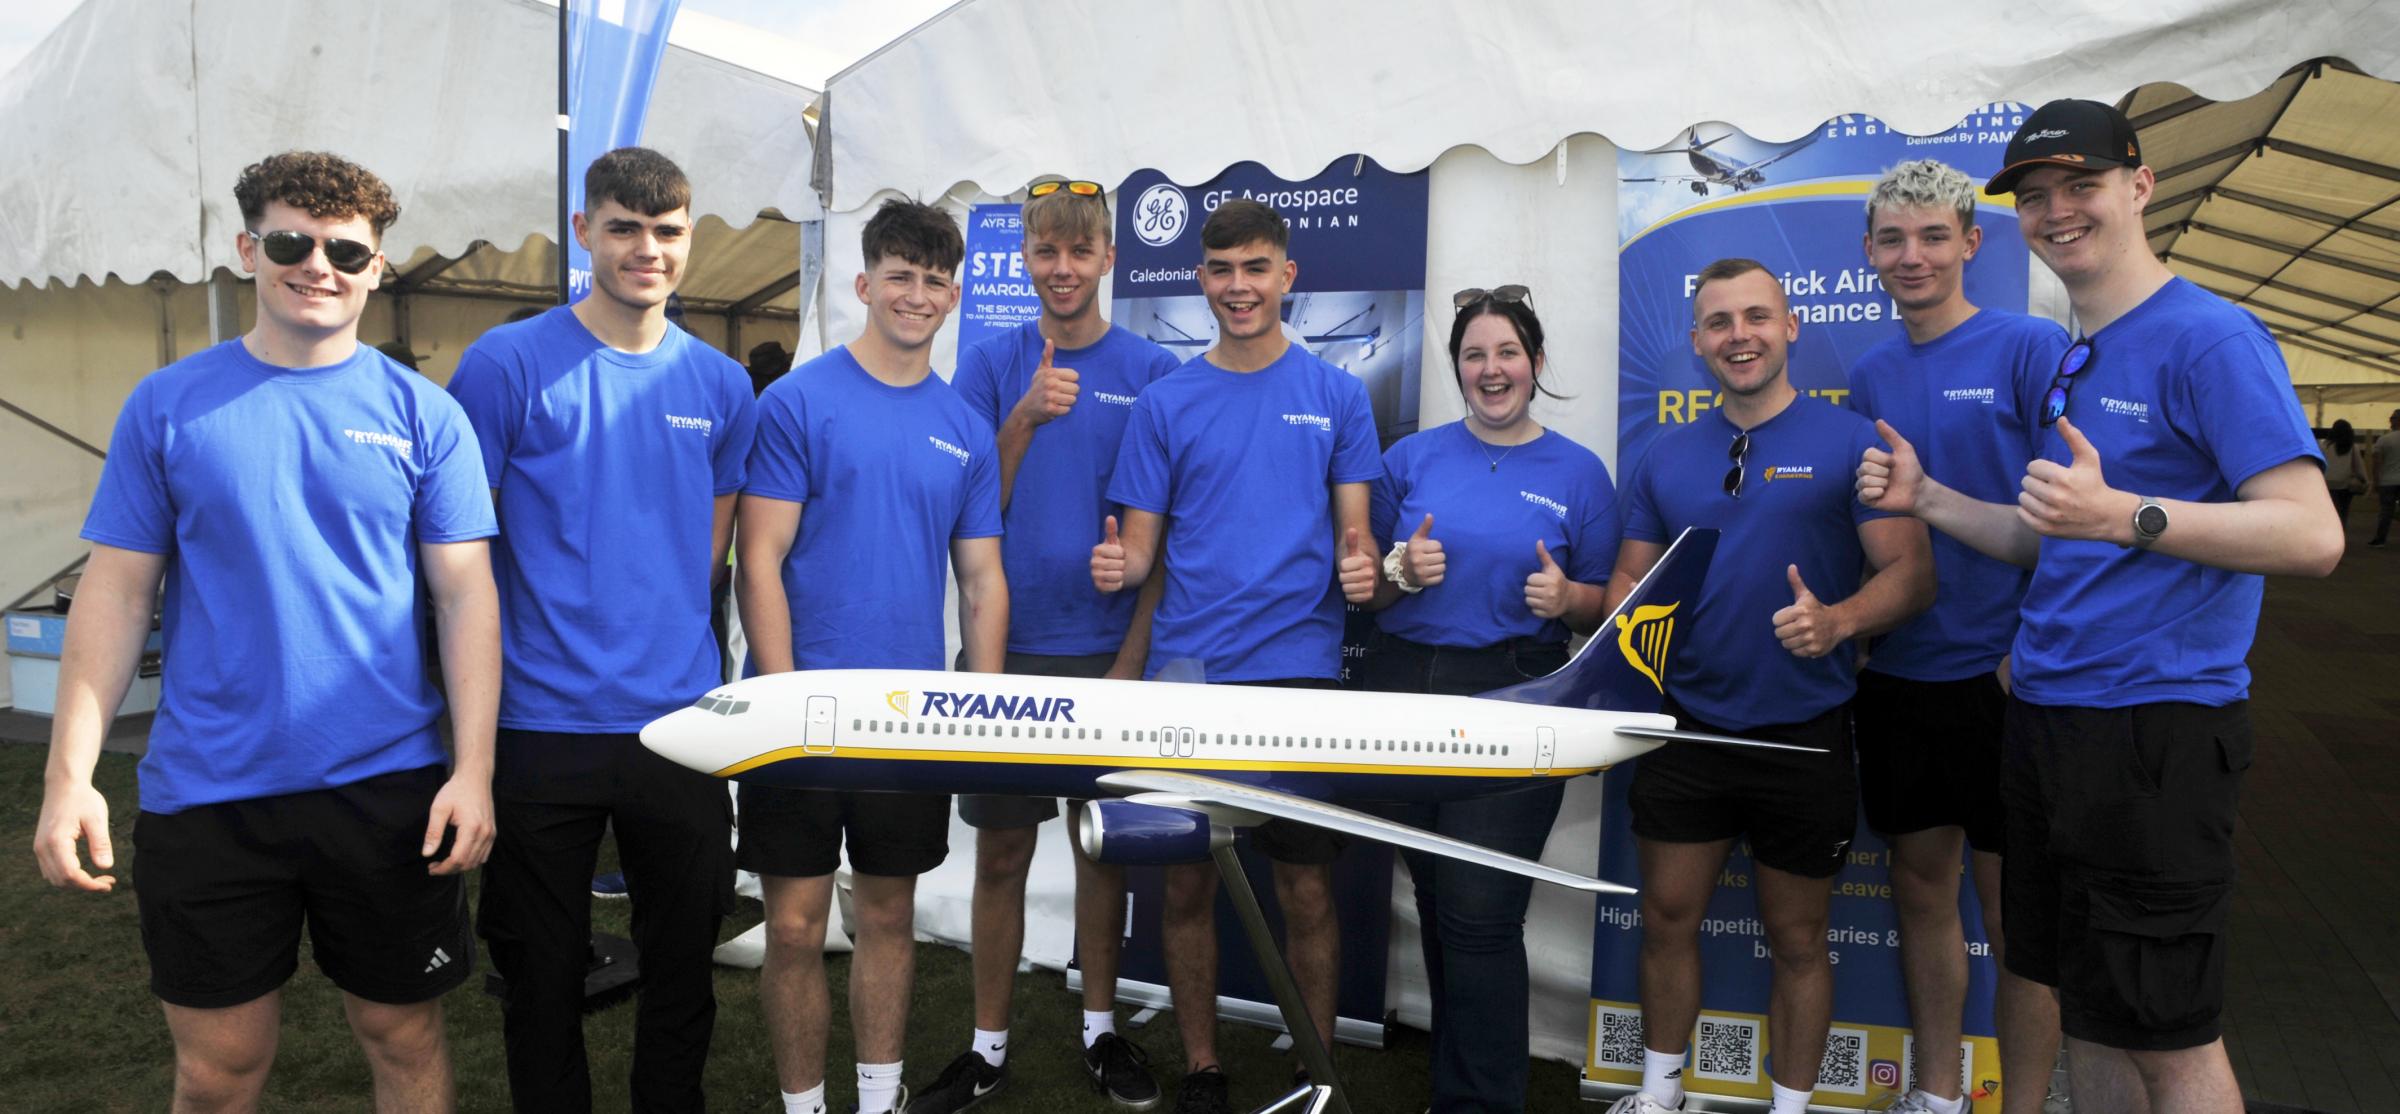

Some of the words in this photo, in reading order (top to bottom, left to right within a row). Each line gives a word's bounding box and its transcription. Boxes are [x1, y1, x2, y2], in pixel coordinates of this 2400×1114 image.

[1907, 135, 1956, 146] Delivered
[1959, 132, 1973, 144] By
[1978, 131, 2016, 144] PAM
[980, 218, 1005, 229] AYR
[1008, 218, 1024, 229] SH
[1283, 215, 1359, 229] ONIAN
[971, 251, 1024, 278] STE
[976, 304, 995, 314] THE
[996, 305, 1040, 315] SKYWAY
[1776, 466, 1813, 474] RYANAIR
[921, 691, 1076, 723] RYANAIR
[1600, 905, 1643, 930] High
[1827, 926, 1879, 946] aries
